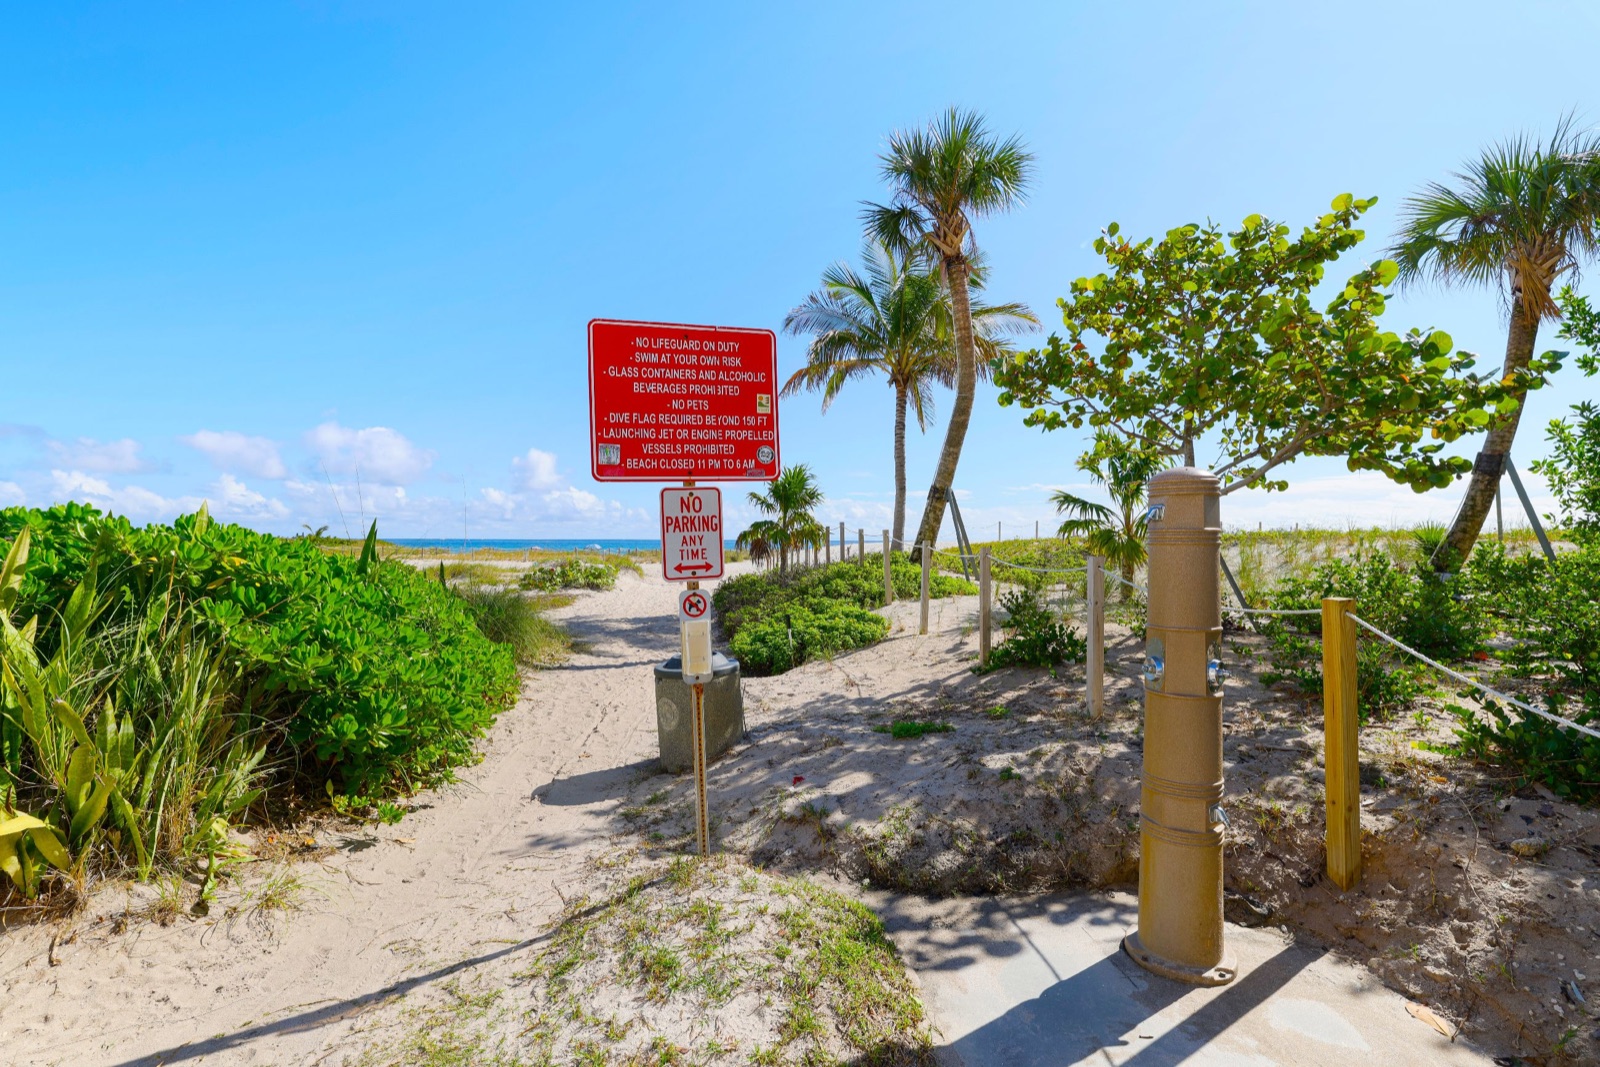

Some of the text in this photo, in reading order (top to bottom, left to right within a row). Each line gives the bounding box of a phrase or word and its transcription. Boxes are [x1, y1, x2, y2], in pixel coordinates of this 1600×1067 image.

[636, 337, 740, 352] NO LIFEGUARD ON DUTY
[635, 352, 742, 367] SWIM AT YOUR OWN RISK
[608, 366, 766, 382] GLASS CONTAINERS AND ALCOHOLIC
[634, 382, 687, 394] BEVERAGES
[672, 399, 708, 410] NO PETS
[610, 412, 768, 426] DIVE FLAG REQUIRED BEYOND 150 FT
[603, 428, 774, 440] LAUNCHING JET OR ENGINE PROPELLED
[642, 444, 735, 454] VESSELS PROHIBITED
[626, 458, 755, 470] BEACH CLOSED 11 PM TO 6 AM
[680, 496, 702, 514] NO
[666, 514, 718, 533] PARKING
[682, 534, 704, 547] ANY
[680, 548, 708, 560] TIME
